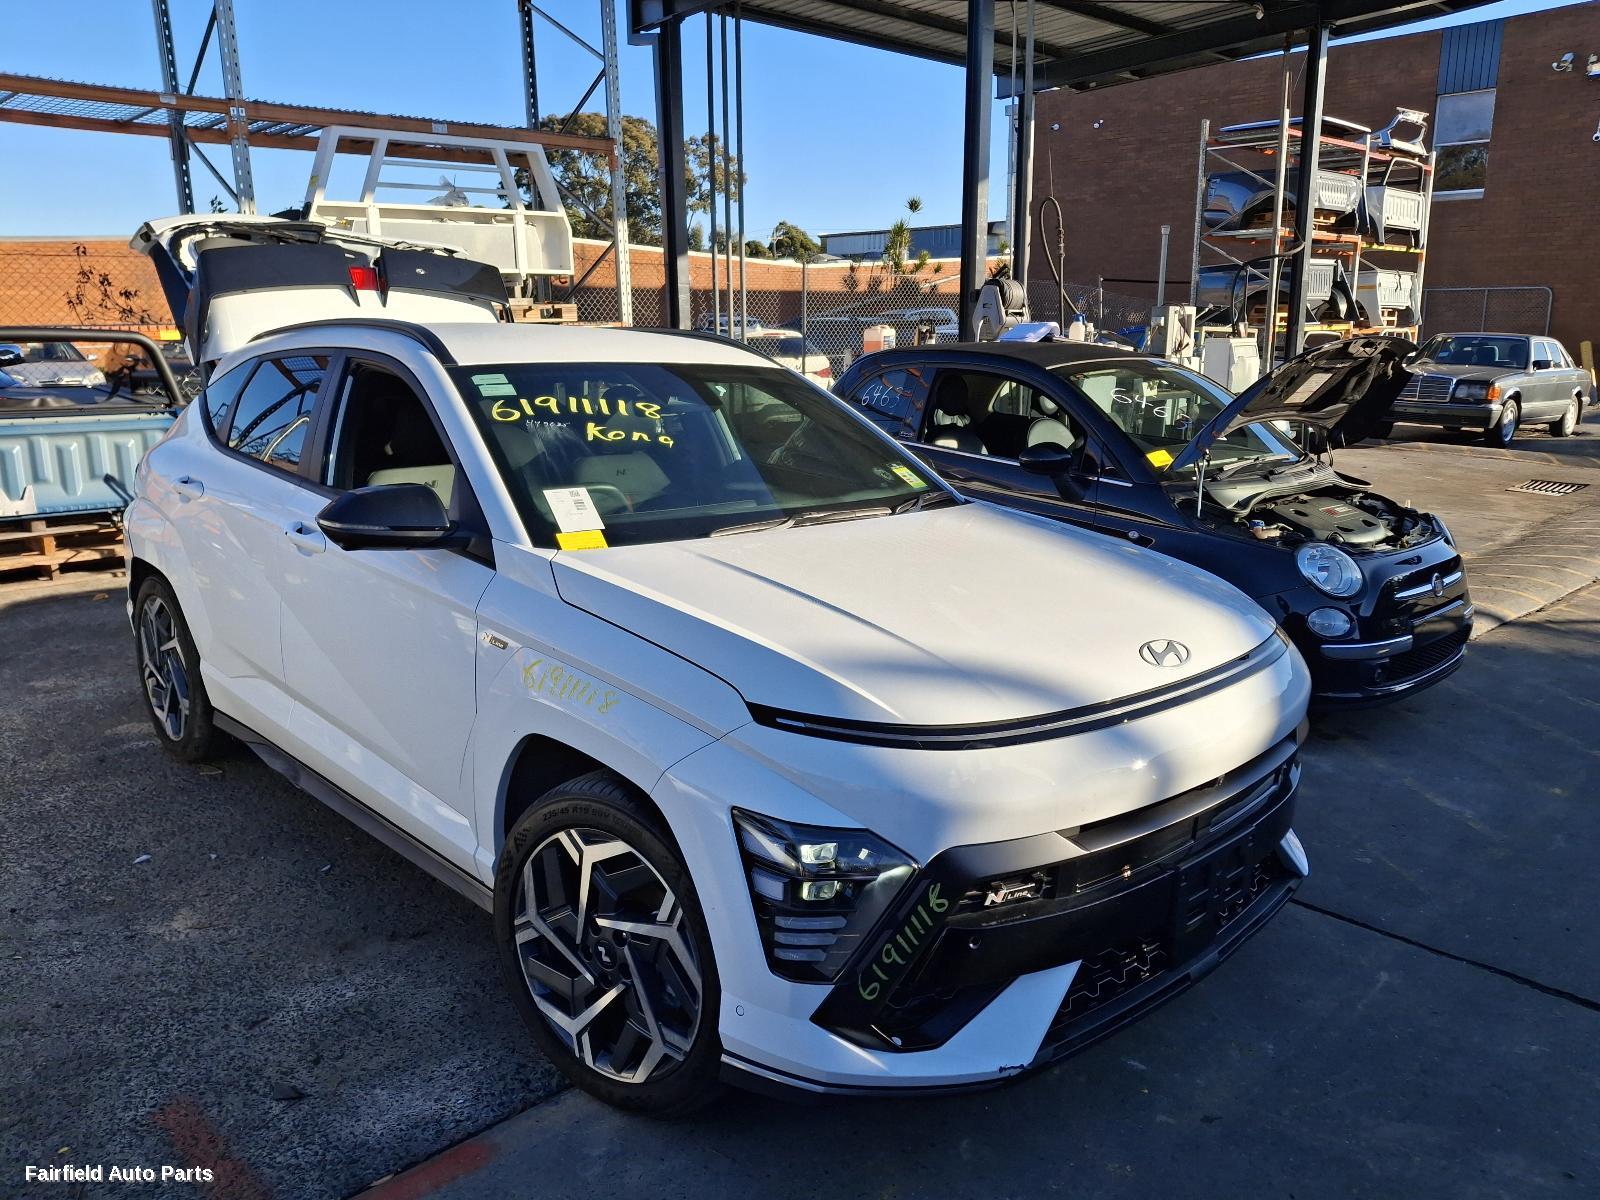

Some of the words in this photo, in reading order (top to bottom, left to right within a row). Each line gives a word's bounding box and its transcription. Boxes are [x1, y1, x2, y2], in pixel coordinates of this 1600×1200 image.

[491, 395, 663, 422] 61911118
[861, 384, 904, 408] 6463
[586, 422, 674, 449] Kona
[984, 891, 1005, 906] N
[858, 882, 949, 1000] 61911118
